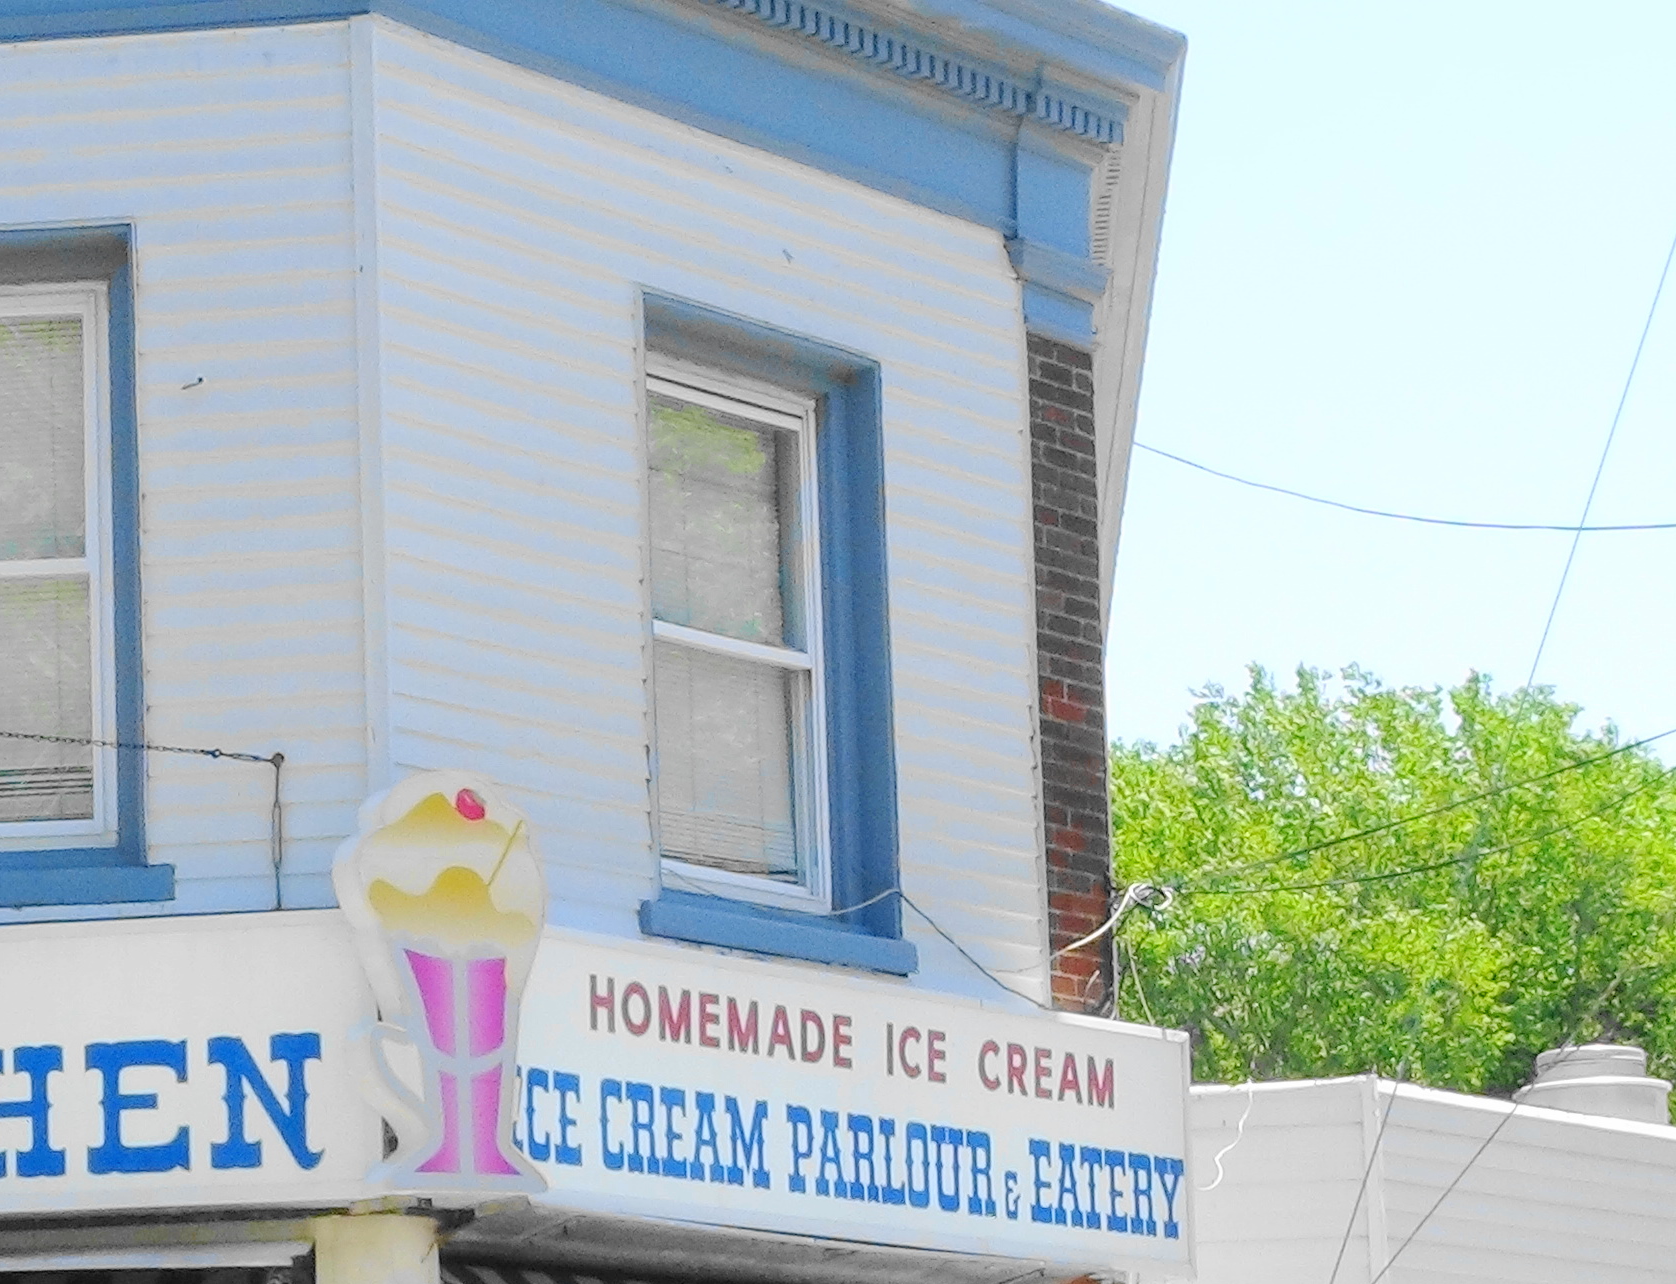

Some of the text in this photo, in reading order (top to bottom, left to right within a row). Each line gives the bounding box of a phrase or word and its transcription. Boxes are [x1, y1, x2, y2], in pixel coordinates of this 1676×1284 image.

[588, 973, 1117, 1111] HOMEMADE ICE CREAM
[600, 1078, 771, 1190] CREAM
[786, 1104, 997, 1217] PARLOUR
[1004, 1169, 1022, 1220] &
[1028, 1137, 1185, 1240] EATERY
